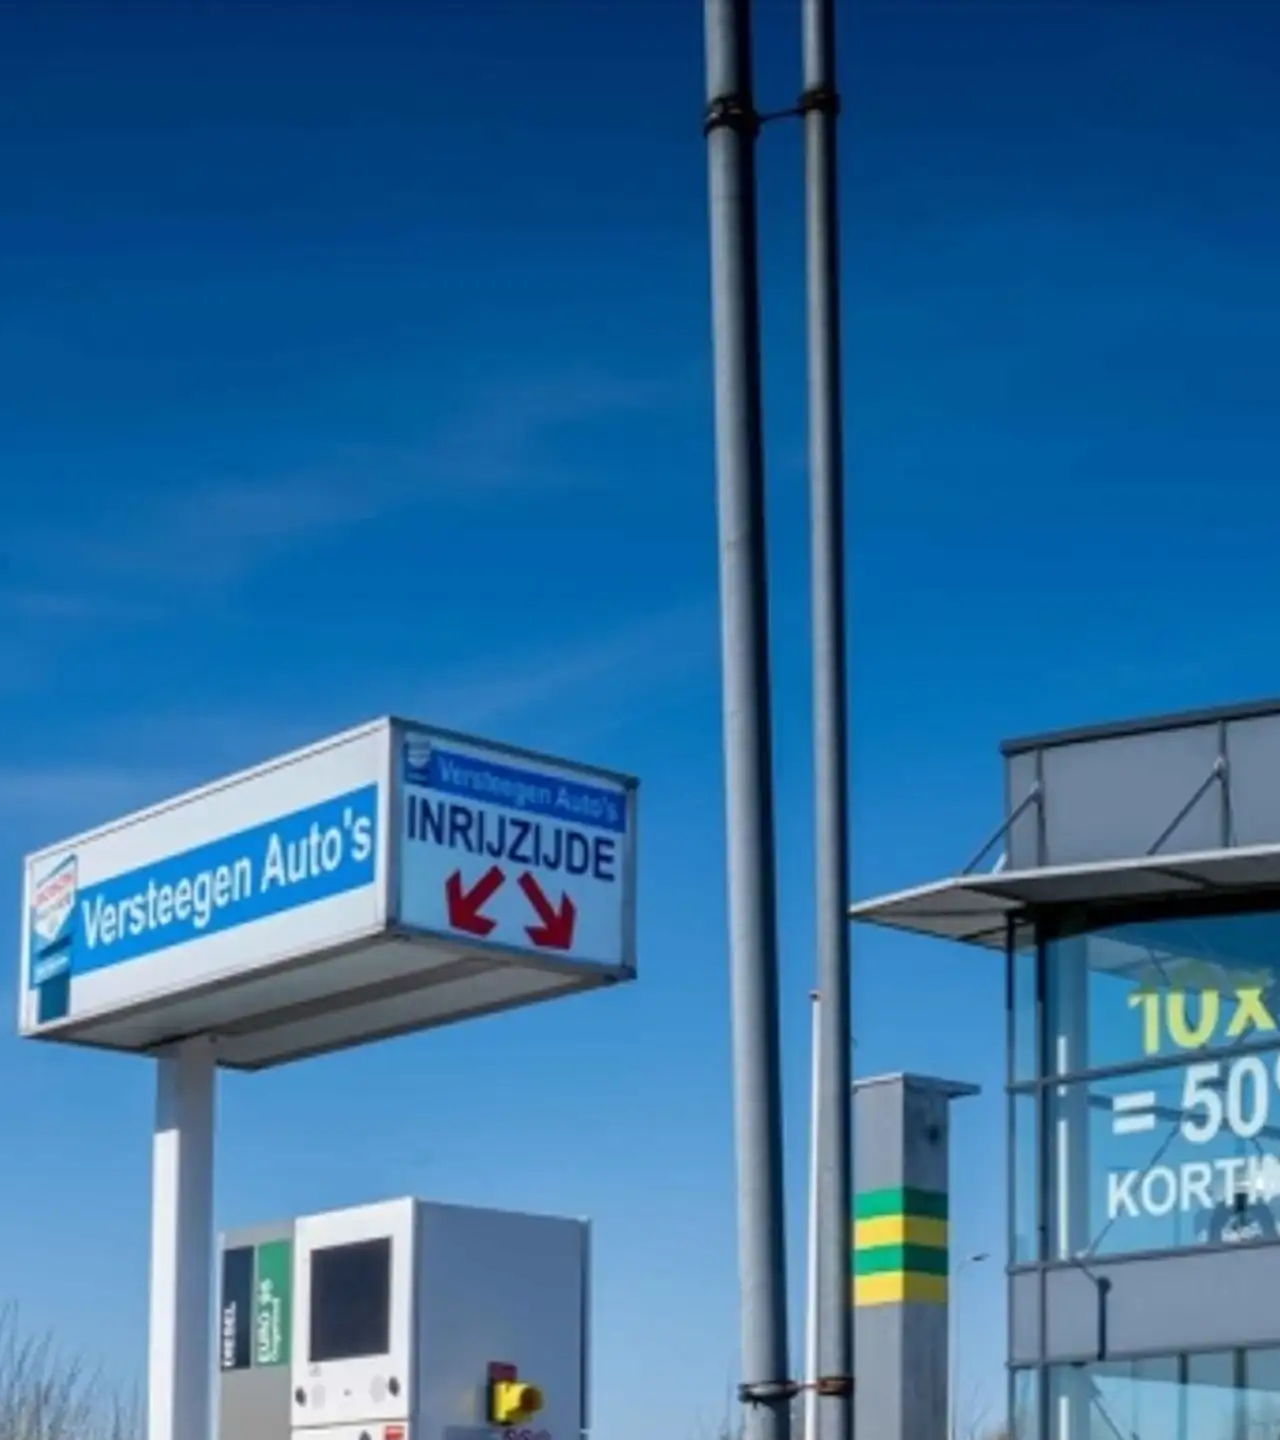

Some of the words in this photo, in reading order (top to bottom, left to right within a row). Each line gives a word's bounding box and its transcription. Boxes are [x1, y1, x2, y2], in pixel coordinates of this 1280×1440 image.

[437, 754, 552, 808] Versteegen
[553, 786, 619, 824] Auto's
[82, 854, 253, 951] Versteegen
[260, 806, 372, 895] Auto's
[407, 795, 616, 883] INRIJZIJDE
[1127, 957, 1276, 1055] 10x
